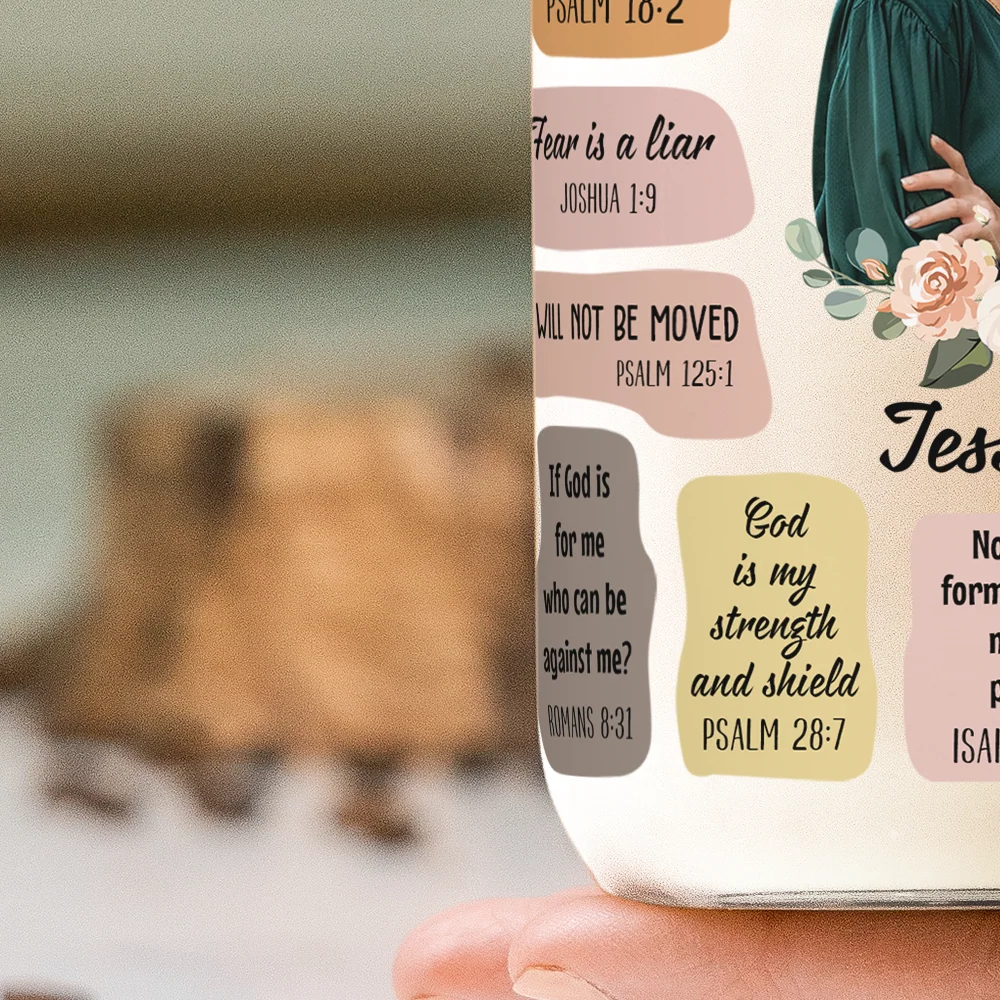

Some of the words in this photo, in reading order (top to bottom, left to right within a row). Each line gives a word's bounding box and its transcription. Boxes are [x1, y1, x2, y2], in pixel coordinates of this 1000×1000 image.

[531, 115, 580, 161] Fear
[585, 121, 605, 161] is
[616, 133, 637, 161] a
[645, 113, 716, 161] liar
[560, 182, 620, 214] JOSHUA
[629, 182, 657, 214] 1:9
[535, 302, 564, 340] WILL
[570, 303, 604, 341] NOT
[614, 304, 638, 342] BE
[650, 304, 739, 343] MOVED
[616, 359, 671, 387] PSALM
[682, 359, 733, 387] 125:1
[548, 462, 562, 498] If
[564, 464, 591, 499] God
[595, 464, 611, 499] is
[744, 496, 811, 539] God
[554, 521, 577, 558] for
[581, 536, 605, 558] me
[543, 581, 570, 615] who
[573, 588, 600, 616] can
[605, 582, 627, 616] be
[732, 552, 756, 587] is
[769, 563, 816, 606] my
[709, 604, 839, 660] strength
[543, 639, 593, 681] against
[596, 640, 632, 675] me?
[690, 661, 755, 698] and
[762, 657, 861, 698] shield
[547, 704, 595, 739] ROMANS
[600, 706, 633, 740] 8:31
[703, 717, 779, 751] PSALM
[792, 717, 846, 751] 28:7
